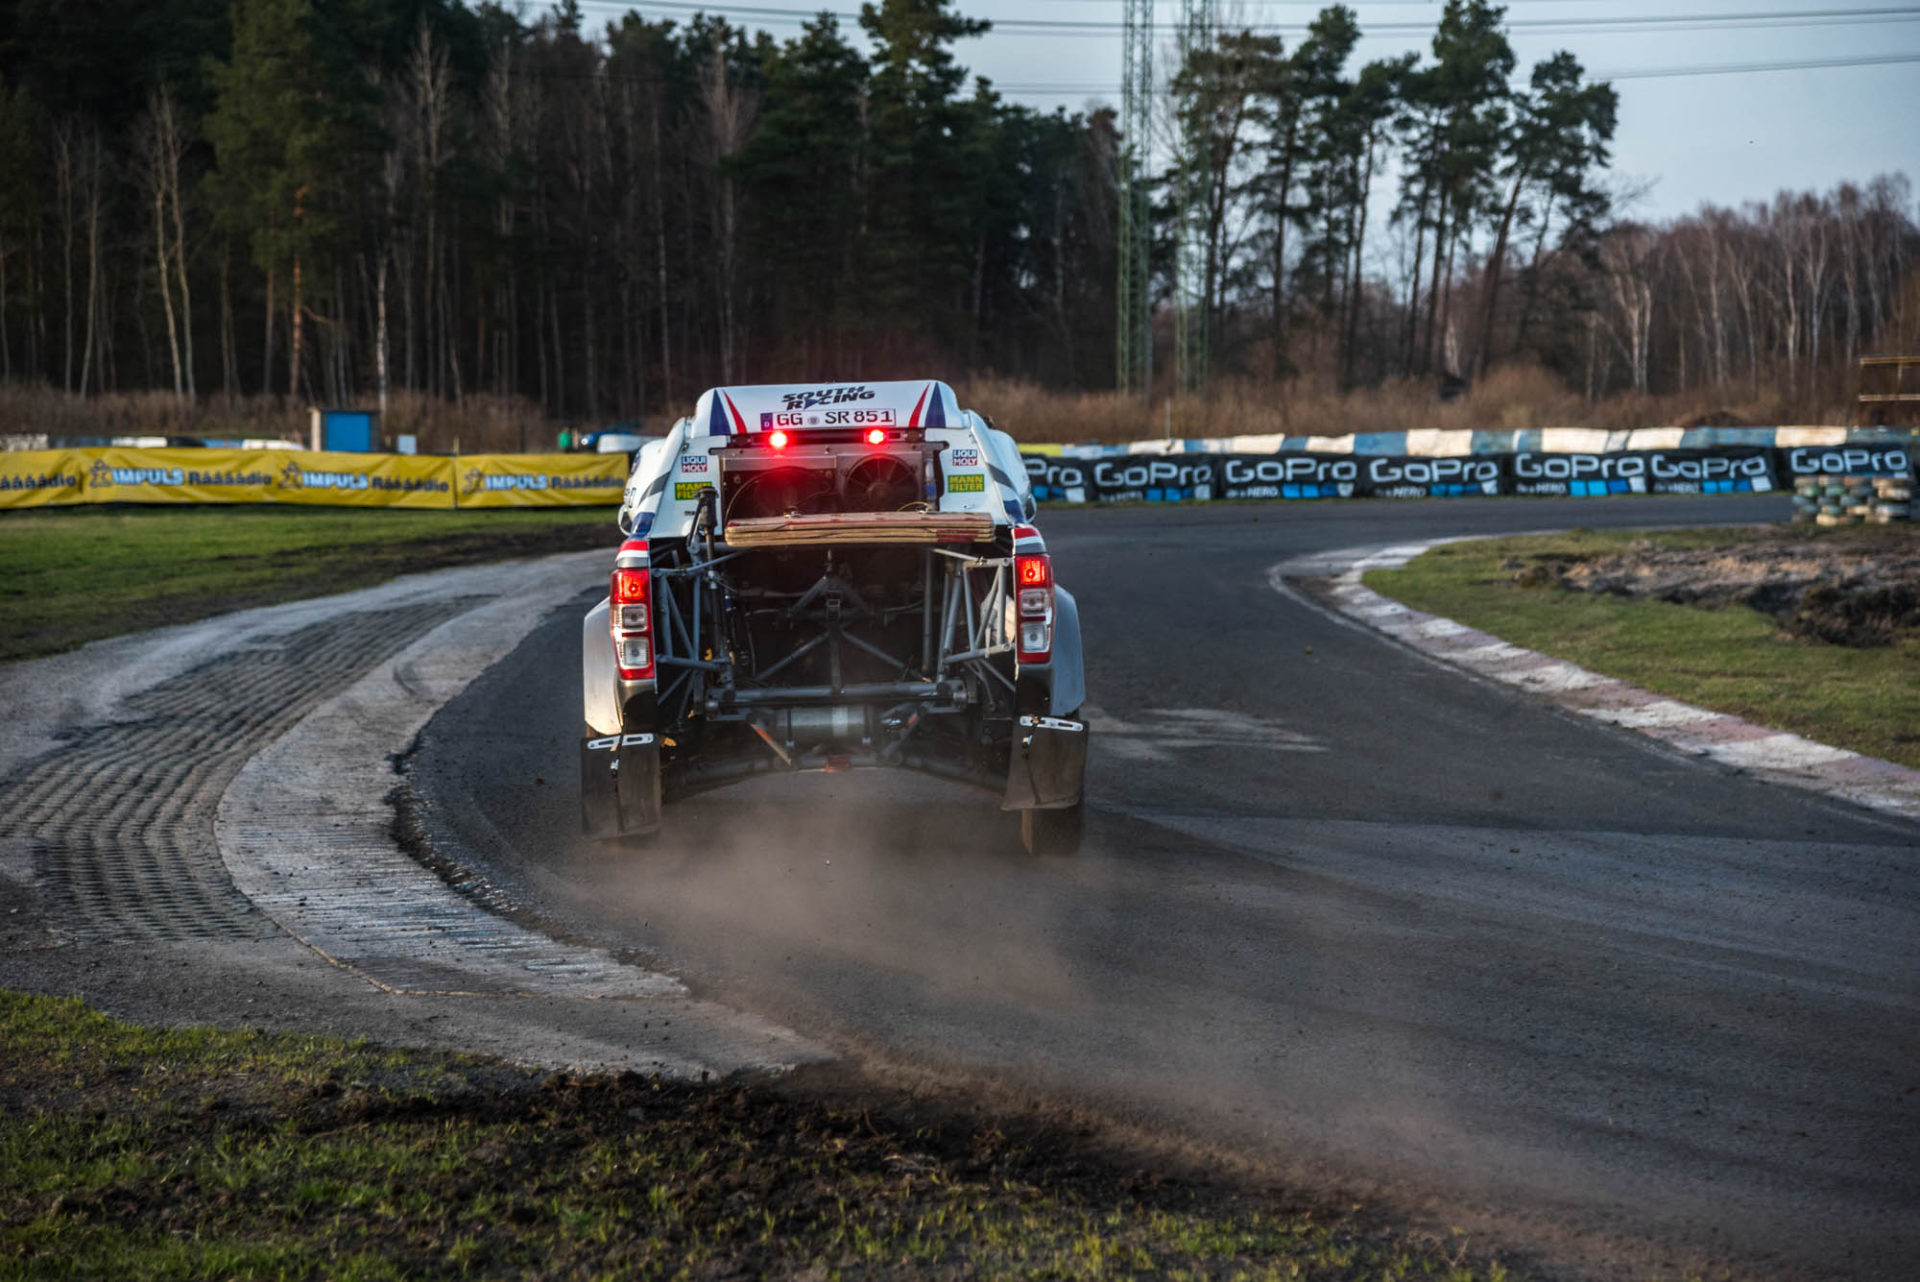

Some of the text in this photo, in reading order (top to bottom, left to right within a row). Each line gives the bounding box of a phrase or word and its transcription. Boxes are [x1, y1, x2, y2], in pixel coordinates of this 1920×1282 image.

[782, 386, 866, 402] SOUTH
[786, 391, 876, 410] RACING
[777, 410, 893, 426] GG SR 851
[953, 449, 978, 457] LIQUI
[953, 458, 978, 466] MOLY
[1791, 448, 1907, 473] GoPro
[682, 464, 707, 472] MOLY
[1023, 458, 1082, 486] Pro
[1095, 462, 1212, 486] GoPro
[1225, 457, 1357, 483] GoPro
[1369, 458, 1498, 483] GoPro
[1515, 453, 1645, 478] GoPro
[1651, 454, 1766, 479] GoPro
[0, 473, 77, 491] áááádio
[112, 468, 185, 486] IMPULS
[302, 471, 369, 489] IMPULS
[484, 474, 549, 490] IMPULS
[949, 475, 983, 483] MANN
[949, 483, 983, 491] FILTER
